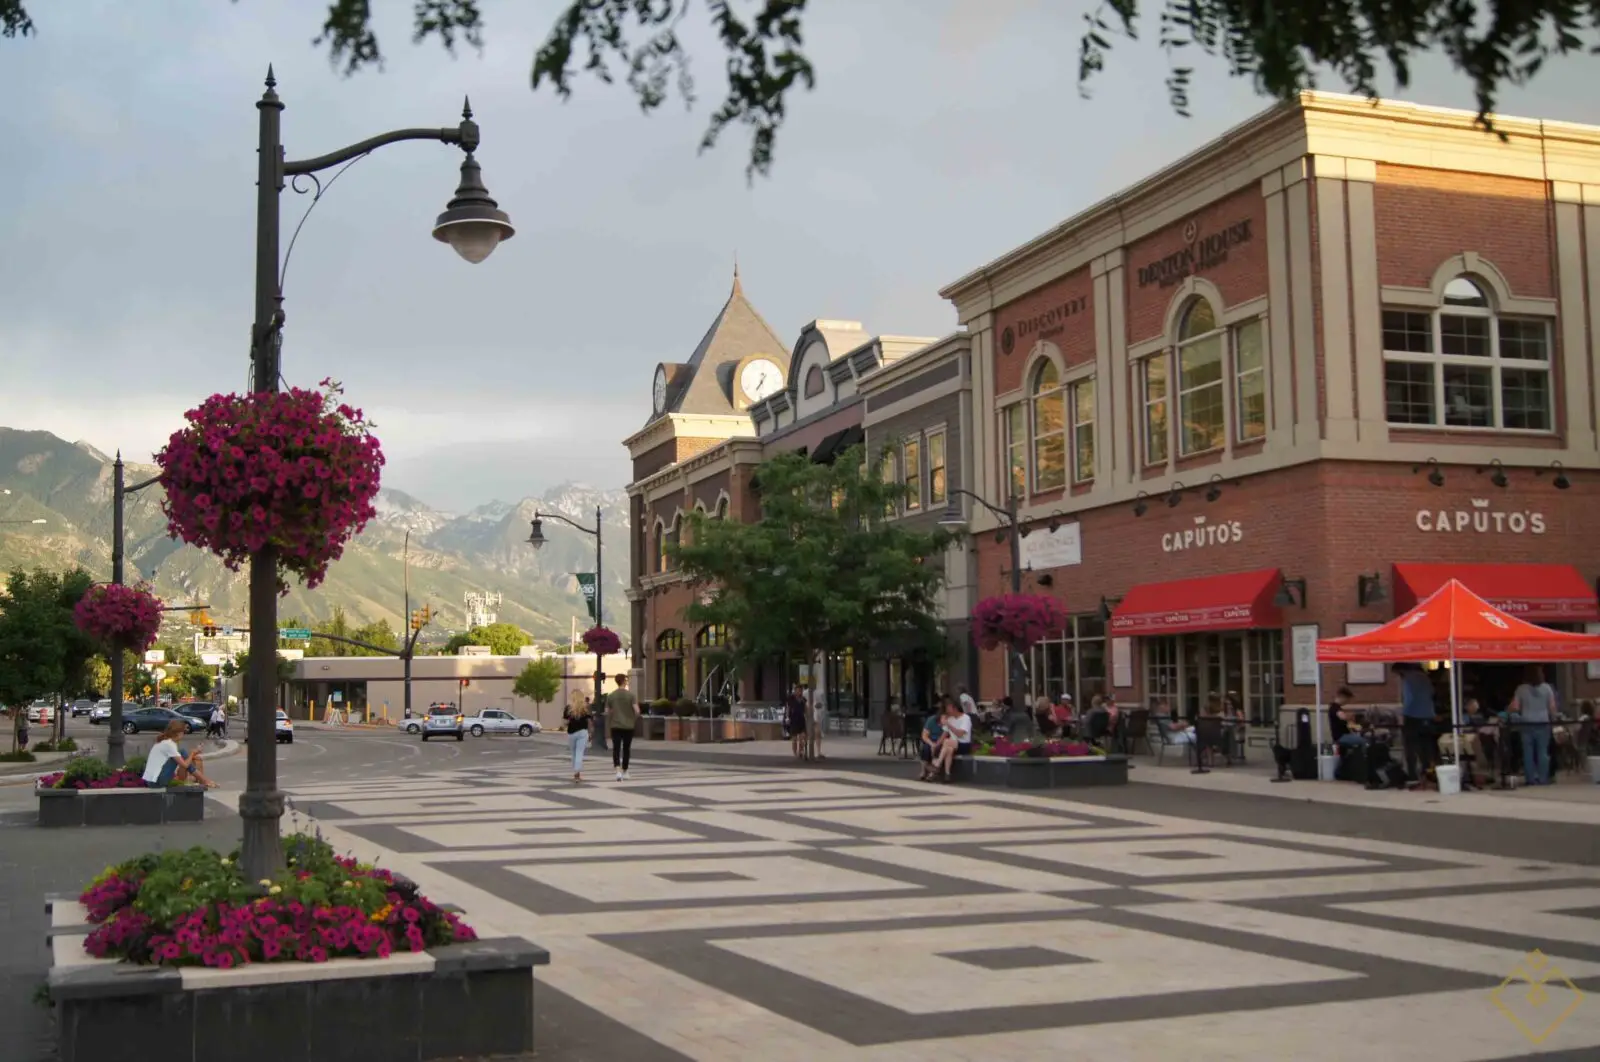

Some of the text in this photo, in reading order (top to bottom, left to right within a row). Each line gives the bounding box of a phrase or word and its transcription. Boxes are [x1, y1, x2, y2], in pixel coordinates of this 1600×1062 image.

[1137, 247, 1196, 287] DENTON
[1199, 218, 1253, 264] HOUSE
[1016, 295, 1088, 337] DISCOVERY
[1161, 520, 1243, 552] CAPUTO'S
[1416, 509, 1546, 534] CAPUTO'S
